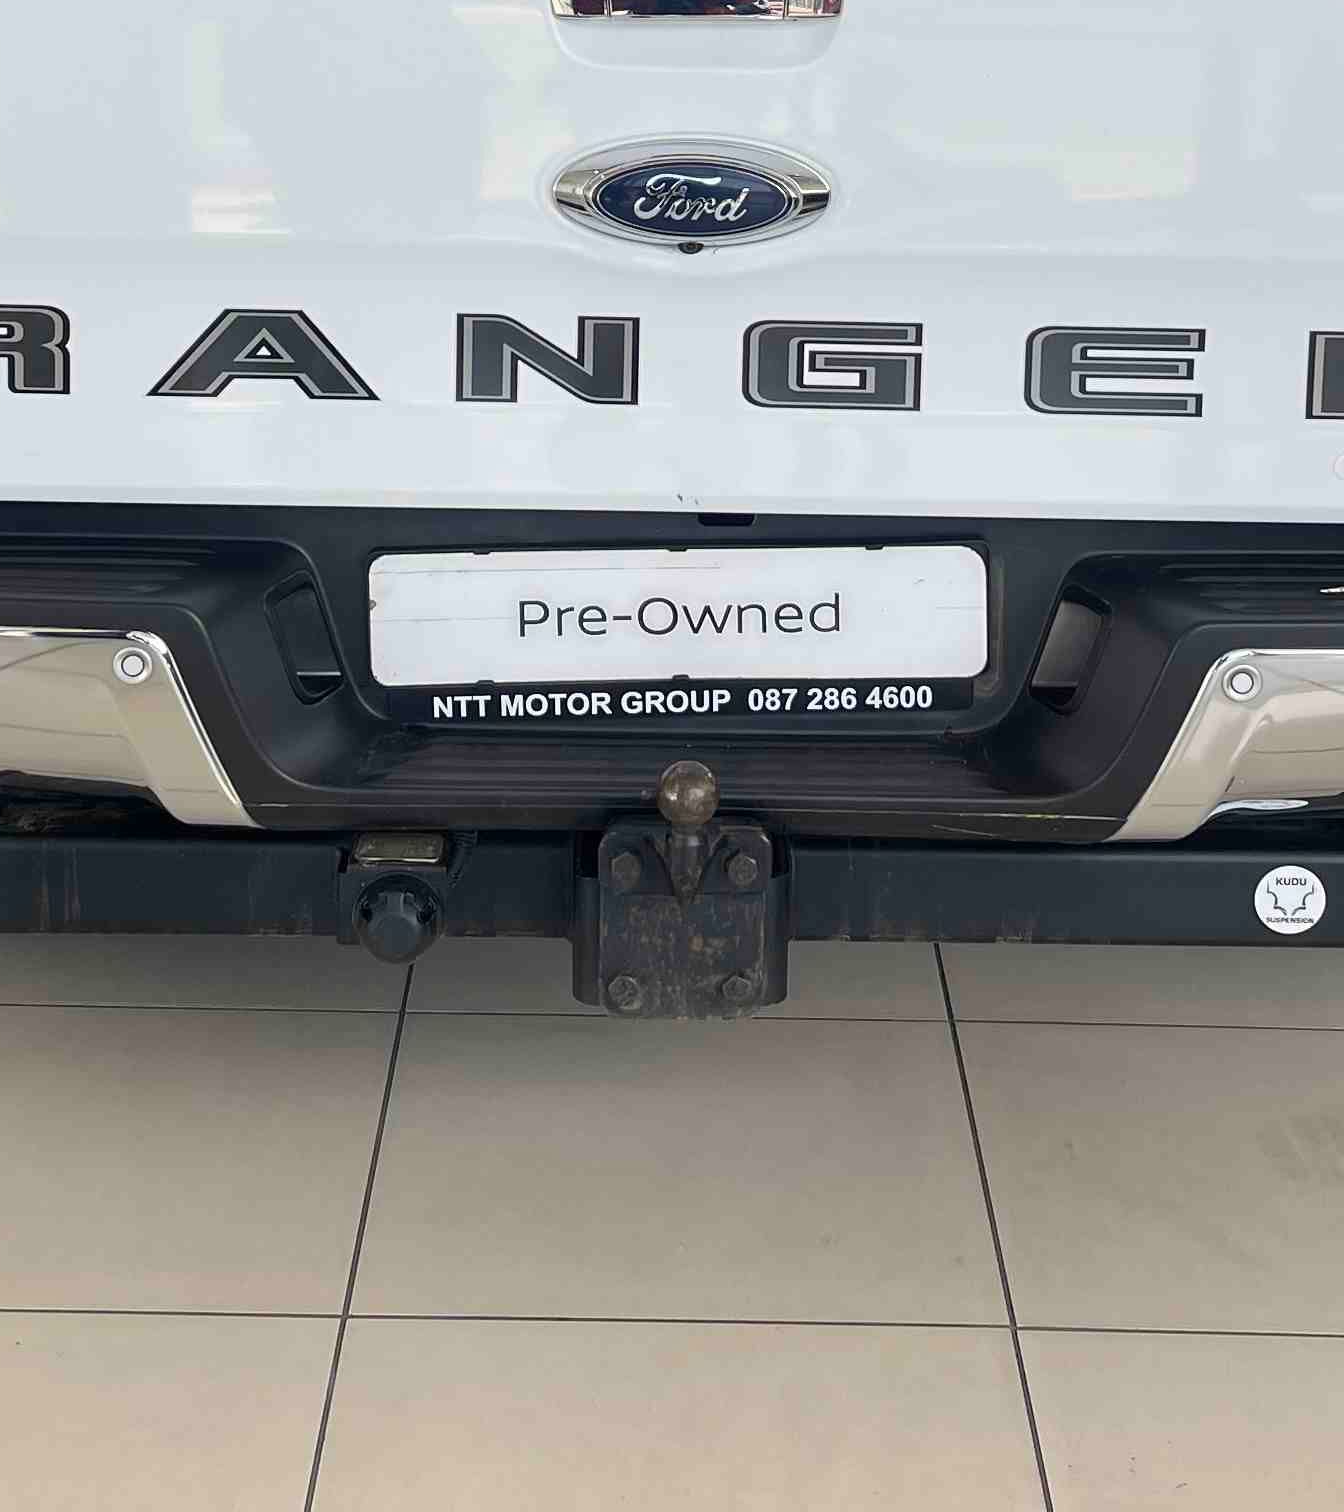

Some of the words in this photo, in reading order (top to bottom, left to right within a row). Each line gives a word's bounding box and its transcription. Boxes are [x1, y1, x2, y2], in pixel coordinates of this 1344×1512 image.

[633, 173, 751, 222] Ford
[518, 593, 841, 637] Pre-Owned
[433, 696, 491, 718] NTT
[500, 692, 612, 717] MOTOR
[620, 689, 731, 714] GROUP
[747, 688, 799, 712] 087
[807, 687, 857, 711] 286
[864, 685, 933, 709] 4600
[1276, 878, 1307, 886] KUDU
